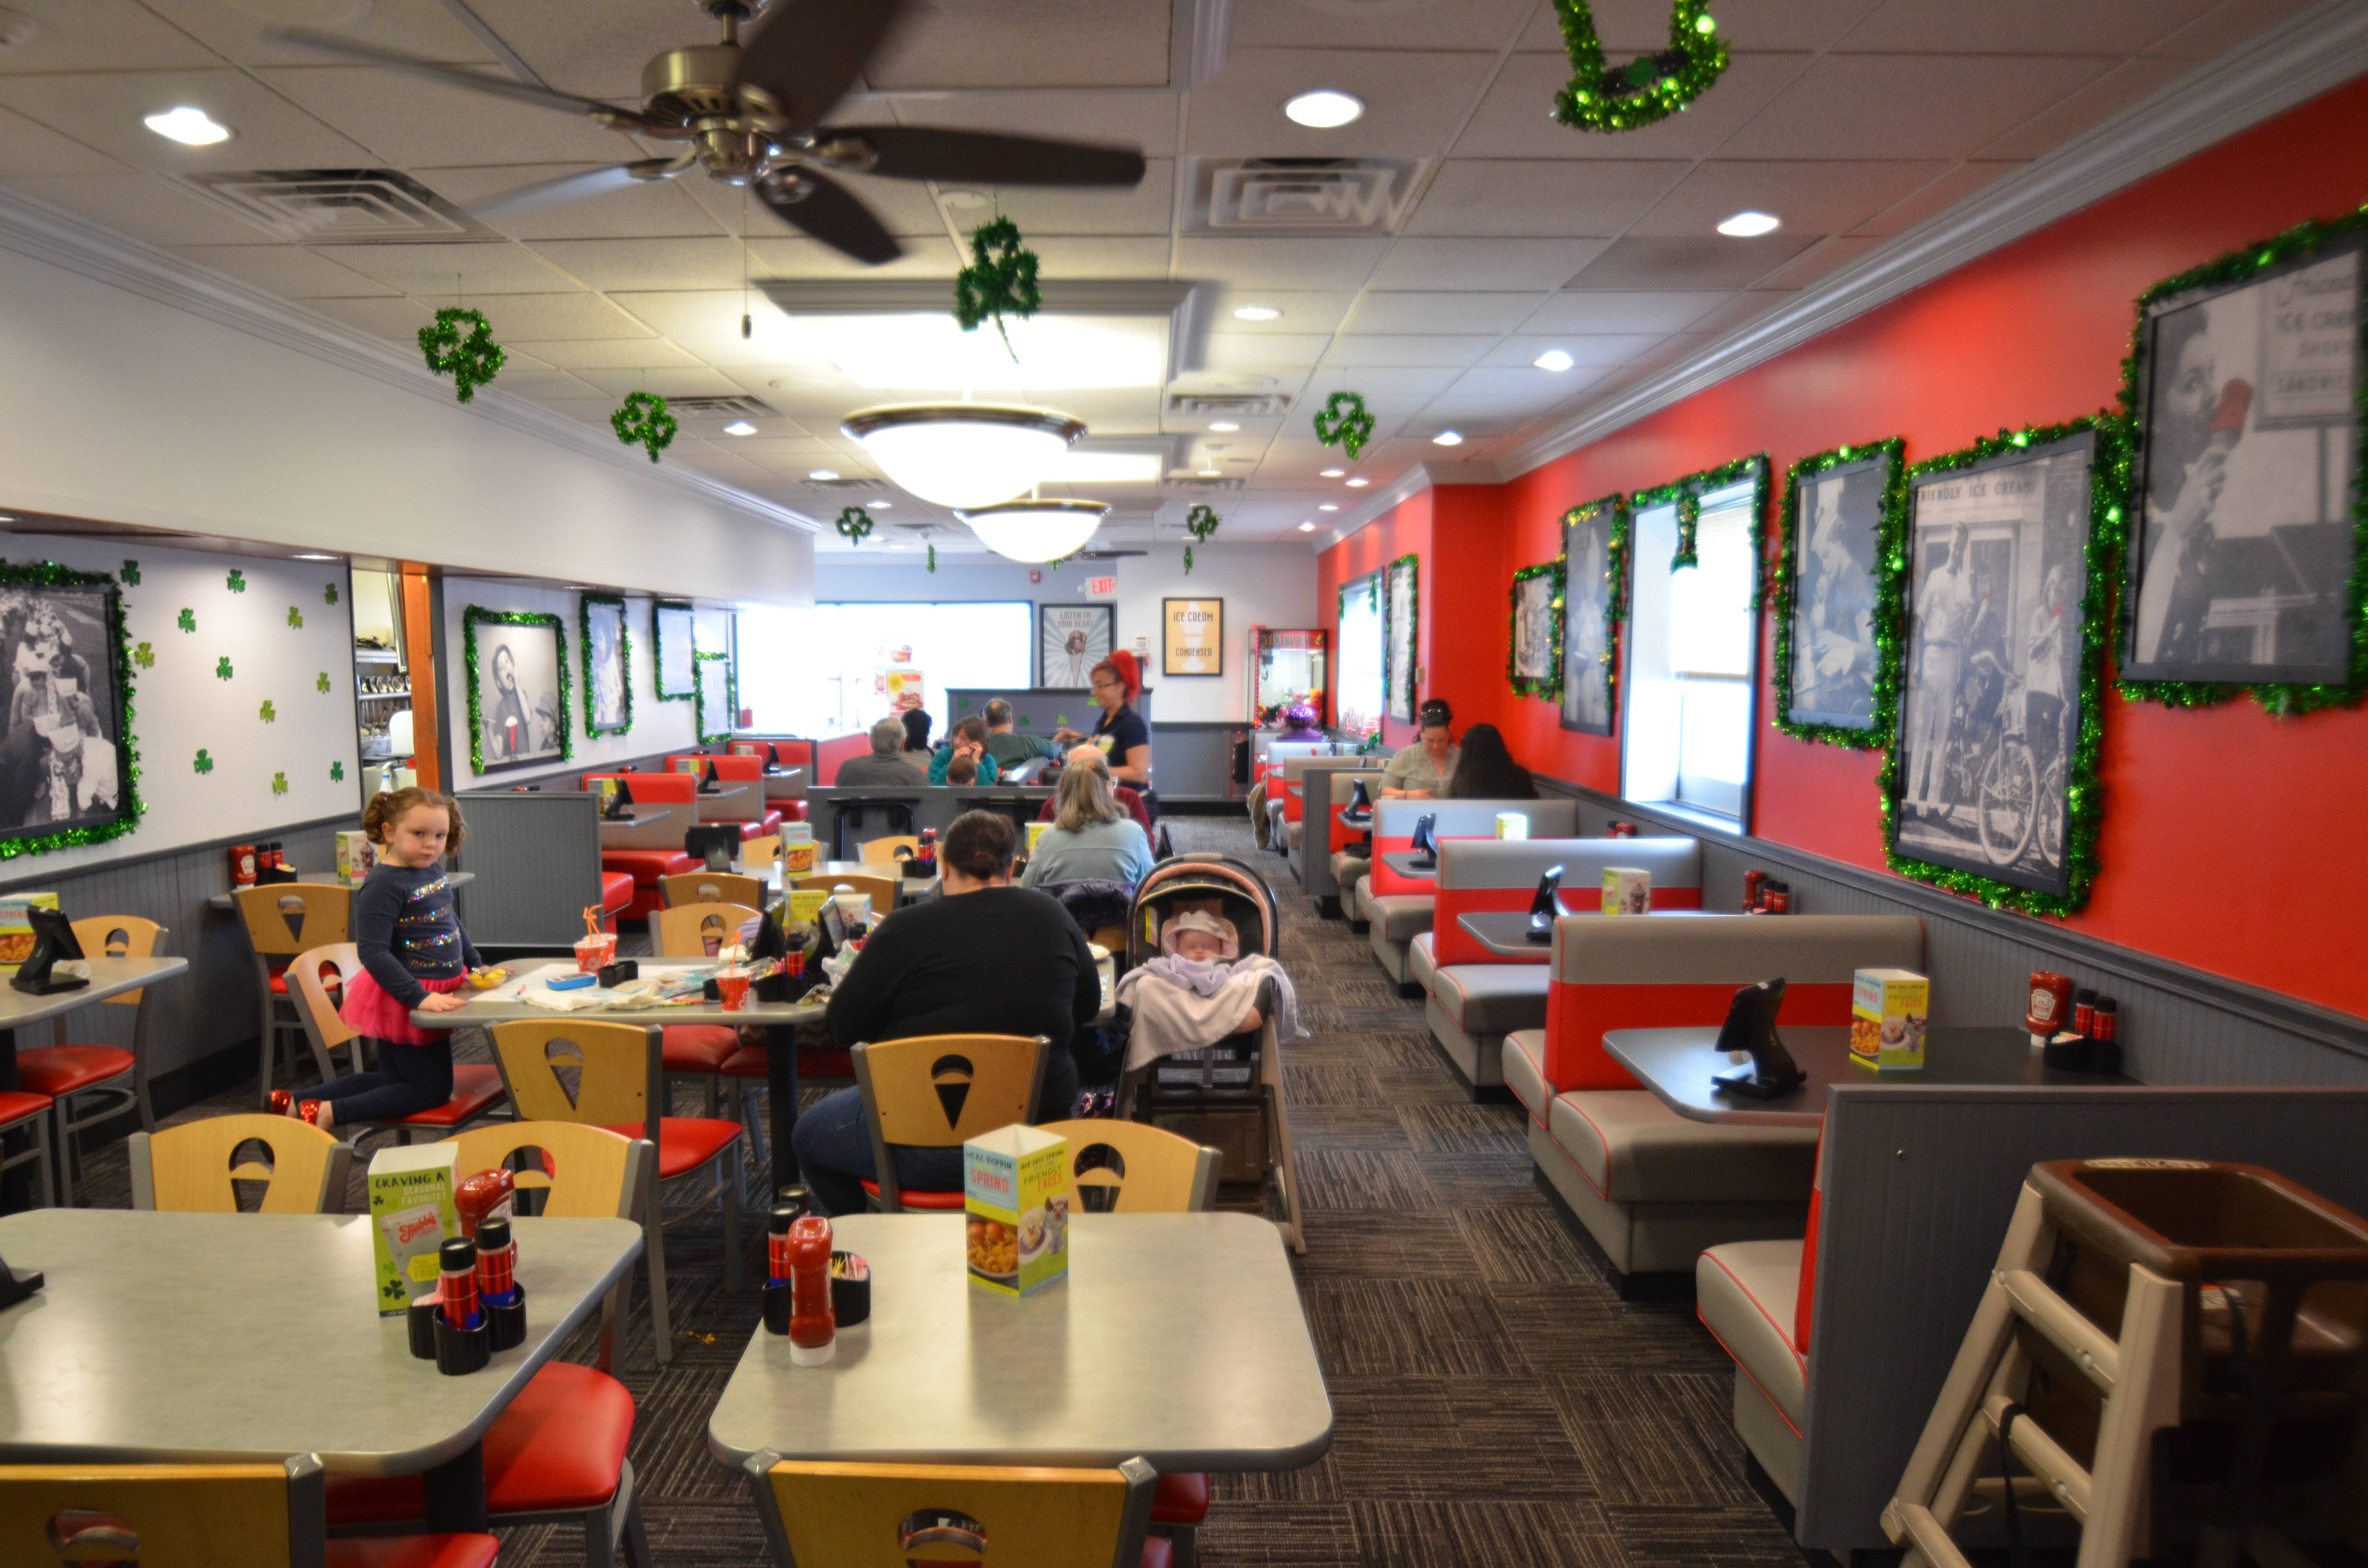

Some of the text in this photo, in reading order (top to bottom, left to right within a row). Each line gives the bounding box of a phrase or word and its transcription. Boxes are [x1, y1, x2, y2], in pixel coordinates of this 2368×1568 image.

[1921, 486, 1962, 501] RIENDLY
[1969, 483, 1986, 497] ICE
[1092, 577, 1113, 594] EXIT
[1084, 611, 1091, 619] TO
[1173, 612, 1213, 622] ICE CREAM
[1175, 648, 1212, 657] CONDENSED
[1046, 1149, 1065, 1161] SPRING
[376, 1172, 445, 1189] CRAVING A
[970, 1168, 1009, 1194] SPRING
[1024, 1164, 1062, 1186] FRIENDLY
[403, 1182, 446, 1195] SEASONAL
[1038, 1172, 1063, 1192] FACES
[402, 1192, 446, 1205] FAVORITE?
[414, 1267, 440, 1279] FRIBB
